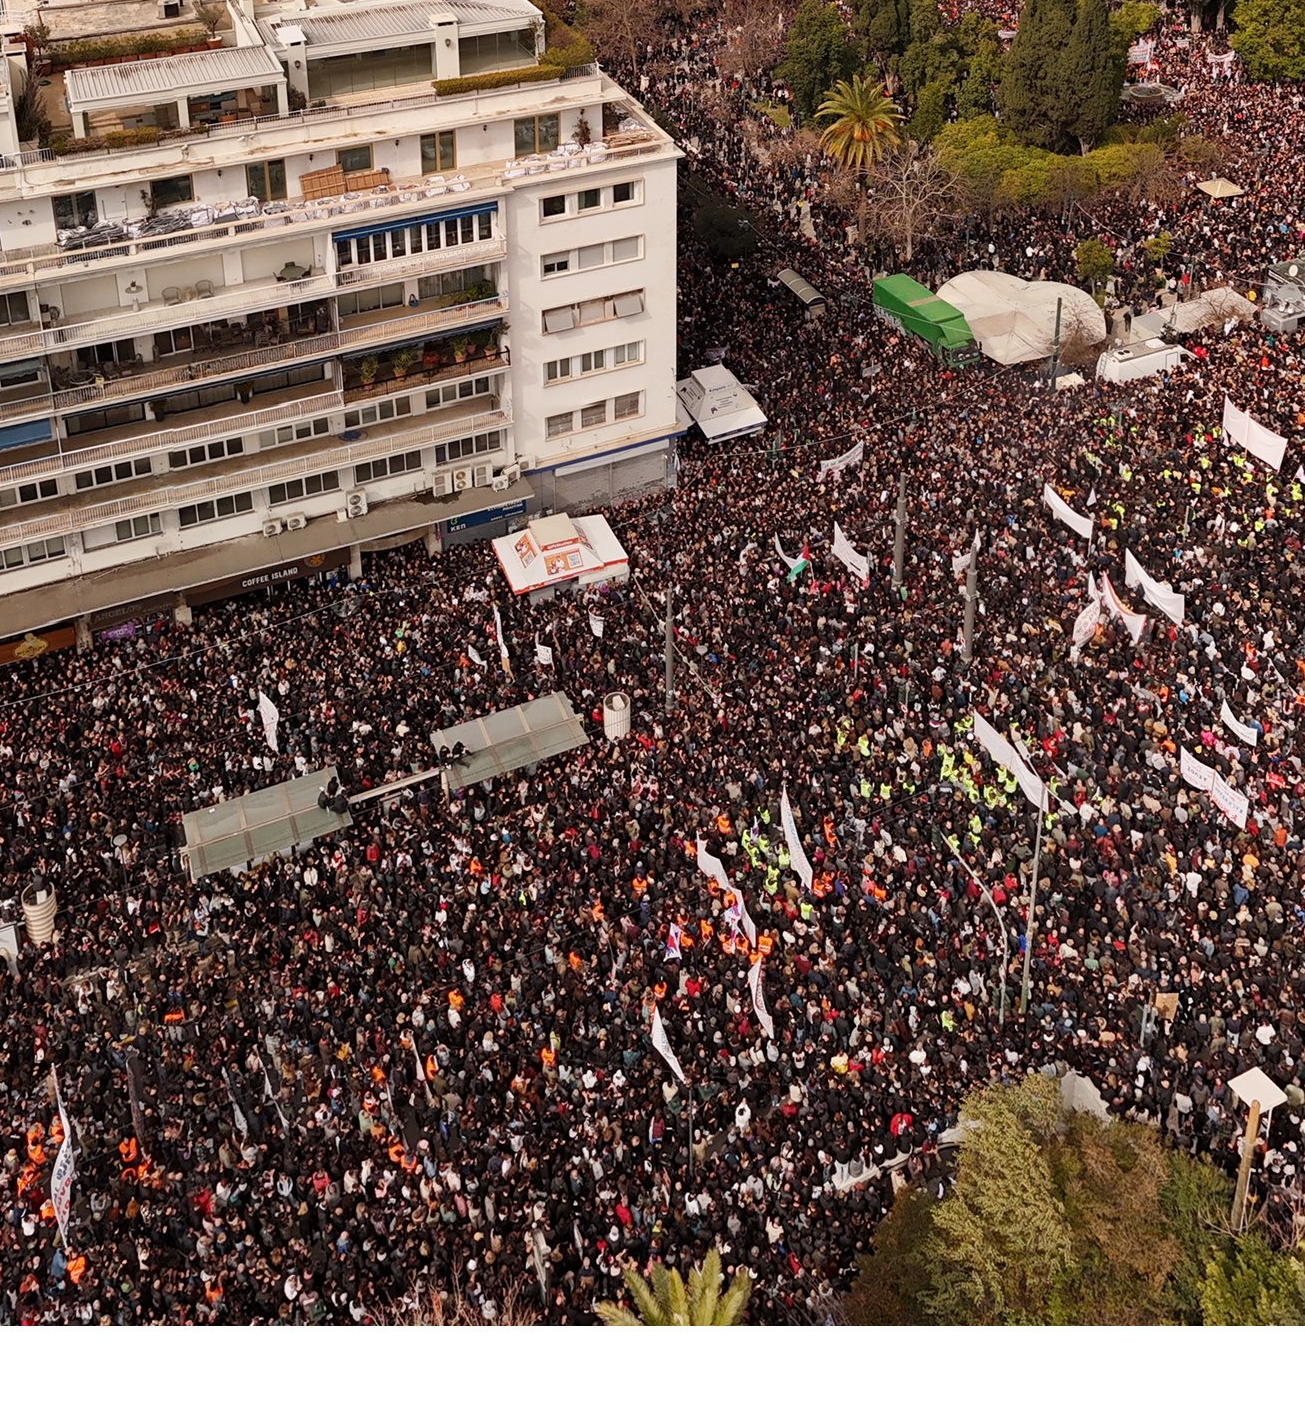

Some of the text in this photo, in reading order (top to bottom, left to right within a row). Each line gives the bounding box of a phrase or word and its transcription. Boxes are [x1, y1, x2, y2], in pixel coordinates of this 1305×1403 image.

[450, 523, 466, 532] ΚΕΠ
[242, 567, 299, 588] COFFEE ISLAND
